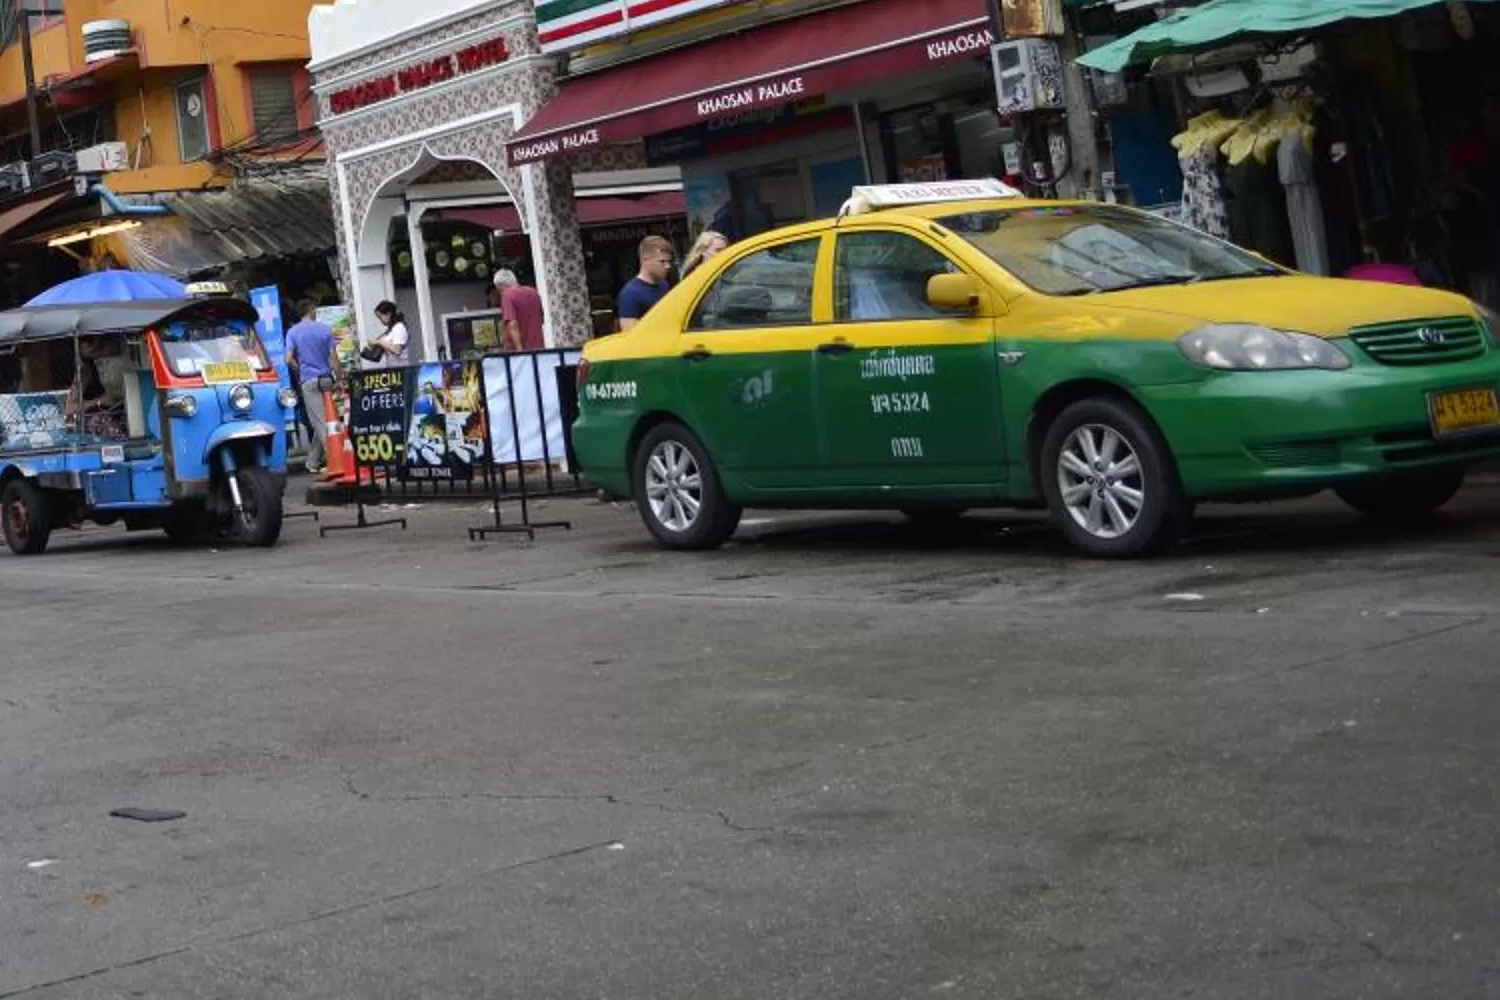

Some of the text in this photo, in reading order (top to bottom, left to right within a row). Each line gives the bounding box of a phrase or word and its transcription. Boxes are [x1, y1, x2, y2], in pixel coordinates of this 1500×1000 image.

[697, 76, 805, 116] KHAOSAN PALACE
[512, 128, 599, 163] KHAOSAN PALACE
[363, 371, 403, 390] SPECIAL
[361, 392, 406, 412] OFFERS
